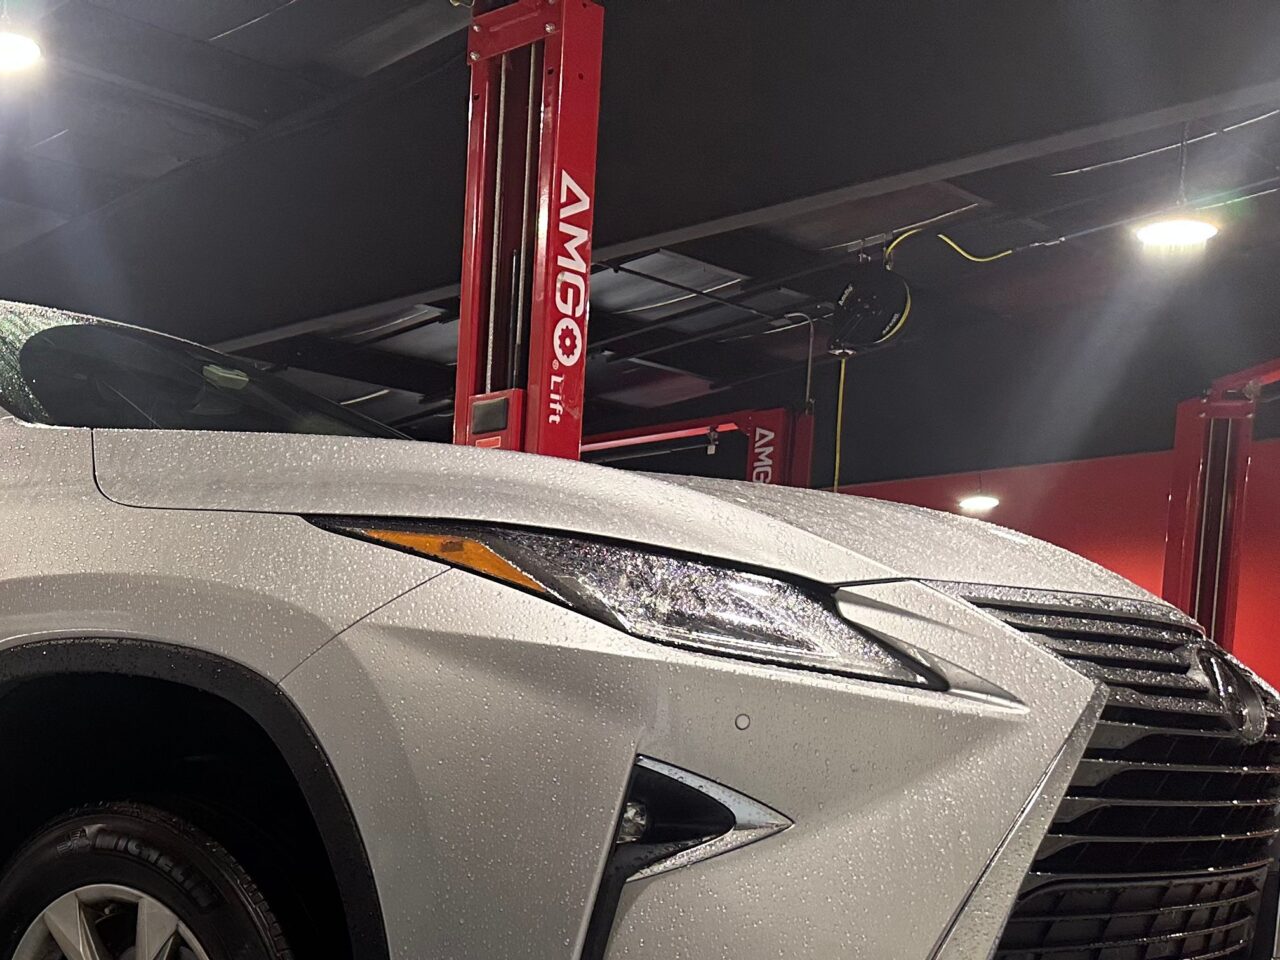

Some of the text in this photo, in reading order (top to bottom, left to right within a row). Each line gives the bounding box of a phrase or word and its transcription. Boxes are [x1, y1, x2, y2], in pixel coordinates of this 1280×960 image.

[548, 169, 590, 424] AMGO Lift
[94, 831, 214, 908] MICHELIN
